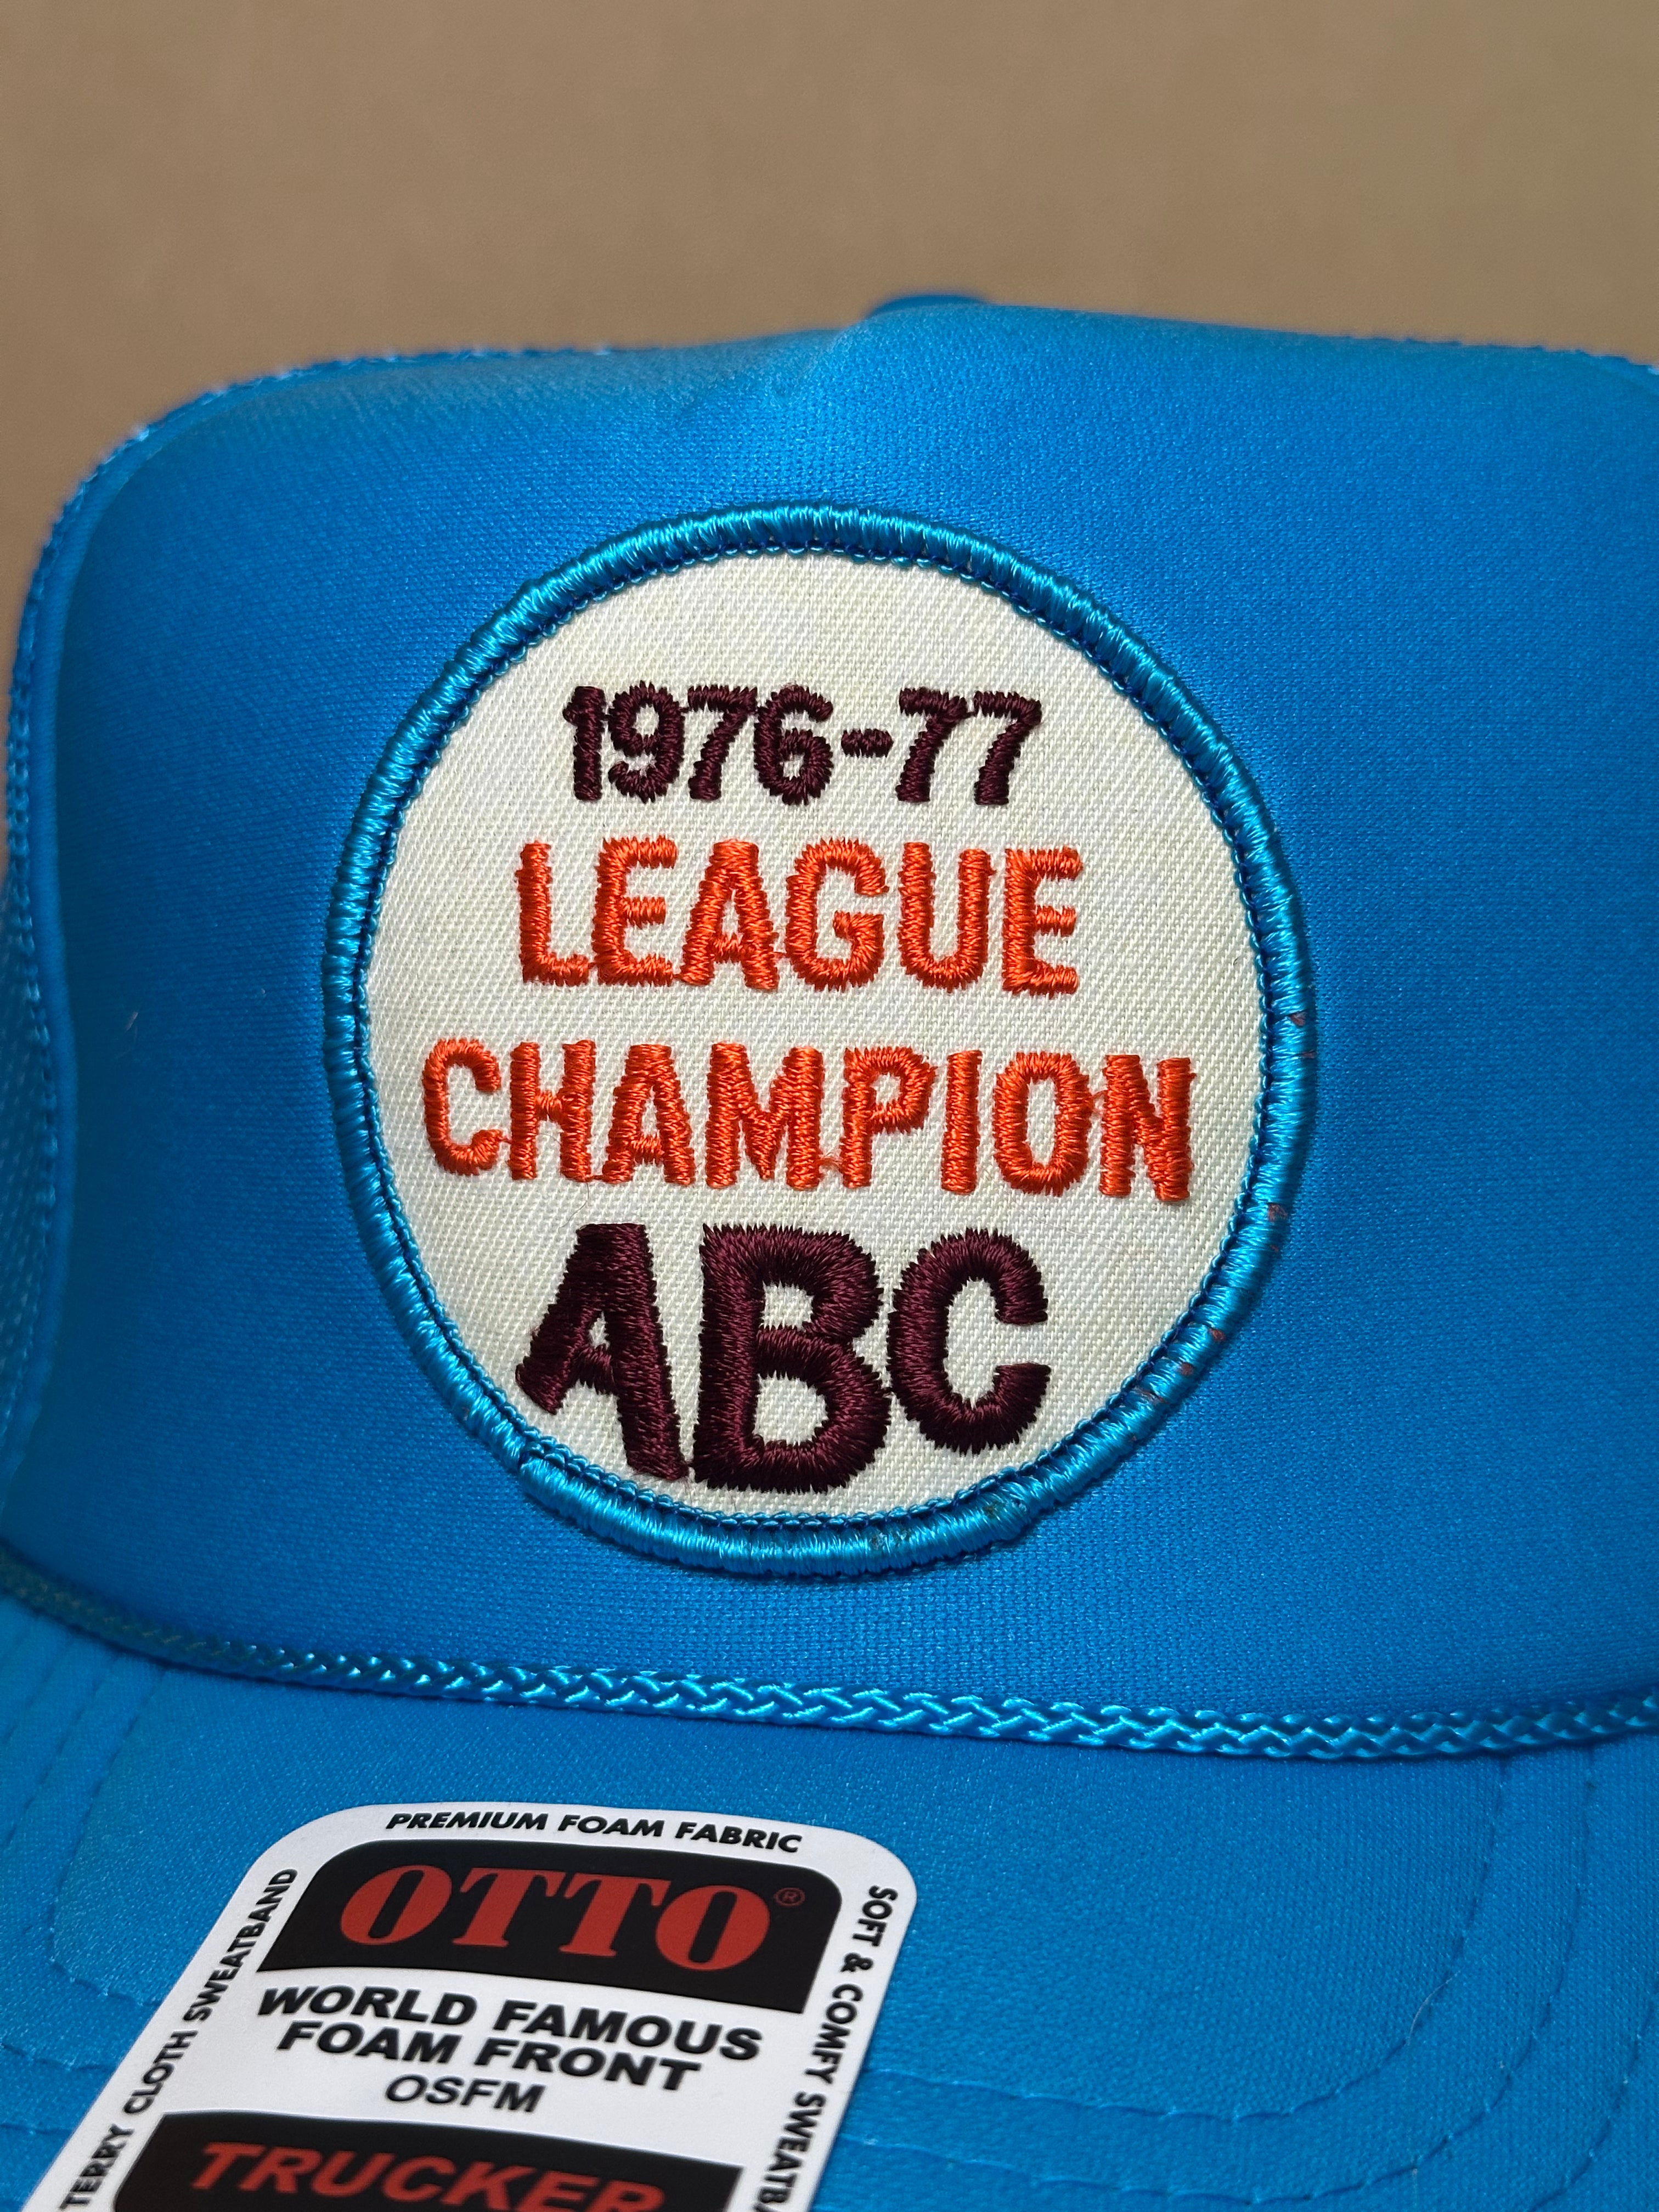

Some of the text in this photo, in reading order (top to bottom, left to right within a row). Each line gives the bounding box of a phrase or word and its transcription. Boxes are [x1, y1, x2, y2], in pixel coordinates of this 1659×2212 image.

[562, 681, 1042, 805] 1976-77
[515, 836, 1083, 997] LEAGUE
[421, 1037, 1195, 1203] CHAMPION
[515, 1222, 1051, 1493] ABC
[386, 1812, 803, 1853] PREMIUM FOAM FABRIC
[340, 1865, 770, 1972] OTTO
[852, 1884, 898, 1947] SOFT
[840, 1953, 874, 1973] &
[59, 1868, 297, 2210] TERRY CLOTH SWEATBAND
[257, 1985, 763, 2061] WORLD FAMOUS
[276, 2021, 702, 2091] FOAM FRONT
[804, 1984, 864, 2084] COMFY
[384, 2074, 545, 2113] OSFM
[191, 2142, 665, 2212] TRUCKER
